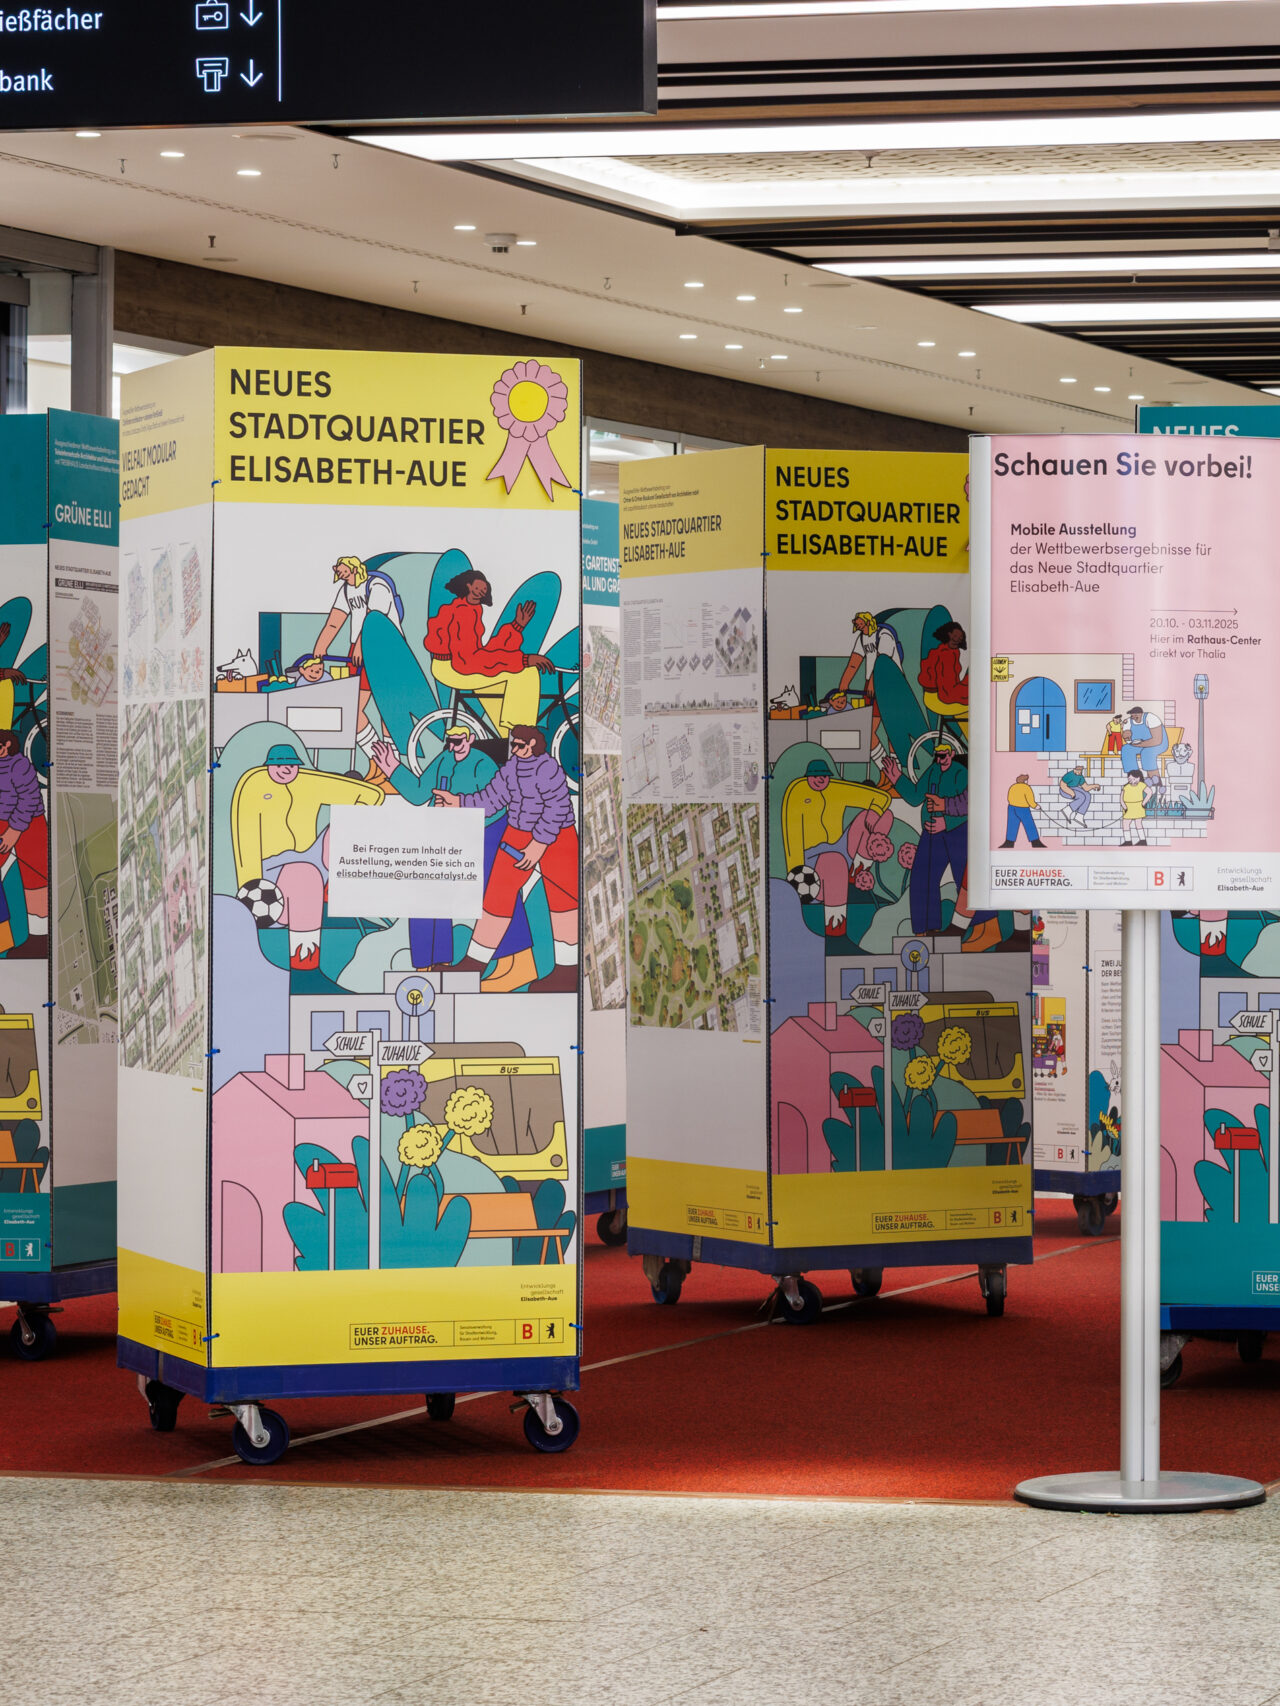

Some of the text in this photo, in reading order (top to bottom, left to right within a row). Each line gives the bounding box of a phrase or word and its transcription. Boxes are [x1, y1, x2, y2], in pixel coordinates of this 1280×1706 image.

[231, 368, 332, 398] NEUES
[229, 411, 486, 445] STADTQUARTIER
[146, 440, 177, 466] MODULAR
[230, 455, 467, 487] ELISABETH-AUE
[993, 452, 1253, 479] Schauen Sie vorbei!
[775, 465, 850, 489] NEUES
[122, 475, 150, 501] GEDACHT
[55, 501, 112, 529] GRÜNE ELLI
[775, 499, 961, 524] STADTQUARTIER
[623, 514, 722, 540] NEUES STADTQUARTIER
[1010, 523, 1137, 539] Mobile Ausstellung
[623, 541, 686, 563] ELISABETH-AUE
[776, 533, 949, 558] ELISABETH-AUE
[1009, 542, 1212, 558] der Wettbewerbsergebnisse für
[585, 555, 619, 573] GARTENST
[1009, 560, 1165, 577] das Neue Stadtquartier
[592, 576, 606, 592] UND
[1010, 580, 1101, 594] Elisabeth-Aue
[348, 594, 368, 610] RUN
[1150, 618, 1180, 629] 20.10.
[1188, 618, 1239, 630] 03.11.2025
[1150, 634, 1262, 646] Hier im Rathaus-Center
[1149, 648, 1226, 660] direkt vor Thalia
[352, 844, 367, 853] Bei
[369, 844, 400, 856] Fragen
[421, 846, 446, 855] Inhalt
[448, 846, 463, 855] der
[339, 857, 475, 868] Ausstellung, wenden Sie sich an
[336, 869, 478, 881] elisabethaue@urbancatalyst.de
[995, 869, 1066, 878] EUER ZUHAUSE.
[1217, 866, 1263, 875] Entwicklungs
[995, 878, 1073, 888] UNSER AUFTRAG.
[1154, 871, 1164, 886] B
[1230, 875, 1273, 884] gesellschaft
[1217, 884, 1265, 892] Elisabeth-Aue
[857, 986, 882, 1000] SCHULE
[891, 993, 922, 1008] ZUHAUSE
[1238, 1014, 1269, 1029] SCHULE
[333, 1034, 368, 1051] SCHULE
[381, 1044, 423, 1062] ZUHAUSE
[499, 1066, 520, 1074] BUS
[1057, 1148, 1064, 1159] B
[875, 1214, 929, 1223] EUER ZUHAUSE.
[993, 1211, 1002, 1224] B
[875, 1221, 935, 1231] UNSER AUFTRAG.
[5, 1242, 15, 1257] B
[1256, 1274, 1279, 1283] EUER
[354, 1325, 430, 1336] EUER ZUHAUSE.
[522, 1323, 533, 1340] B
[354, 1334, 439, 1346] UNSER AUFTRAG.
